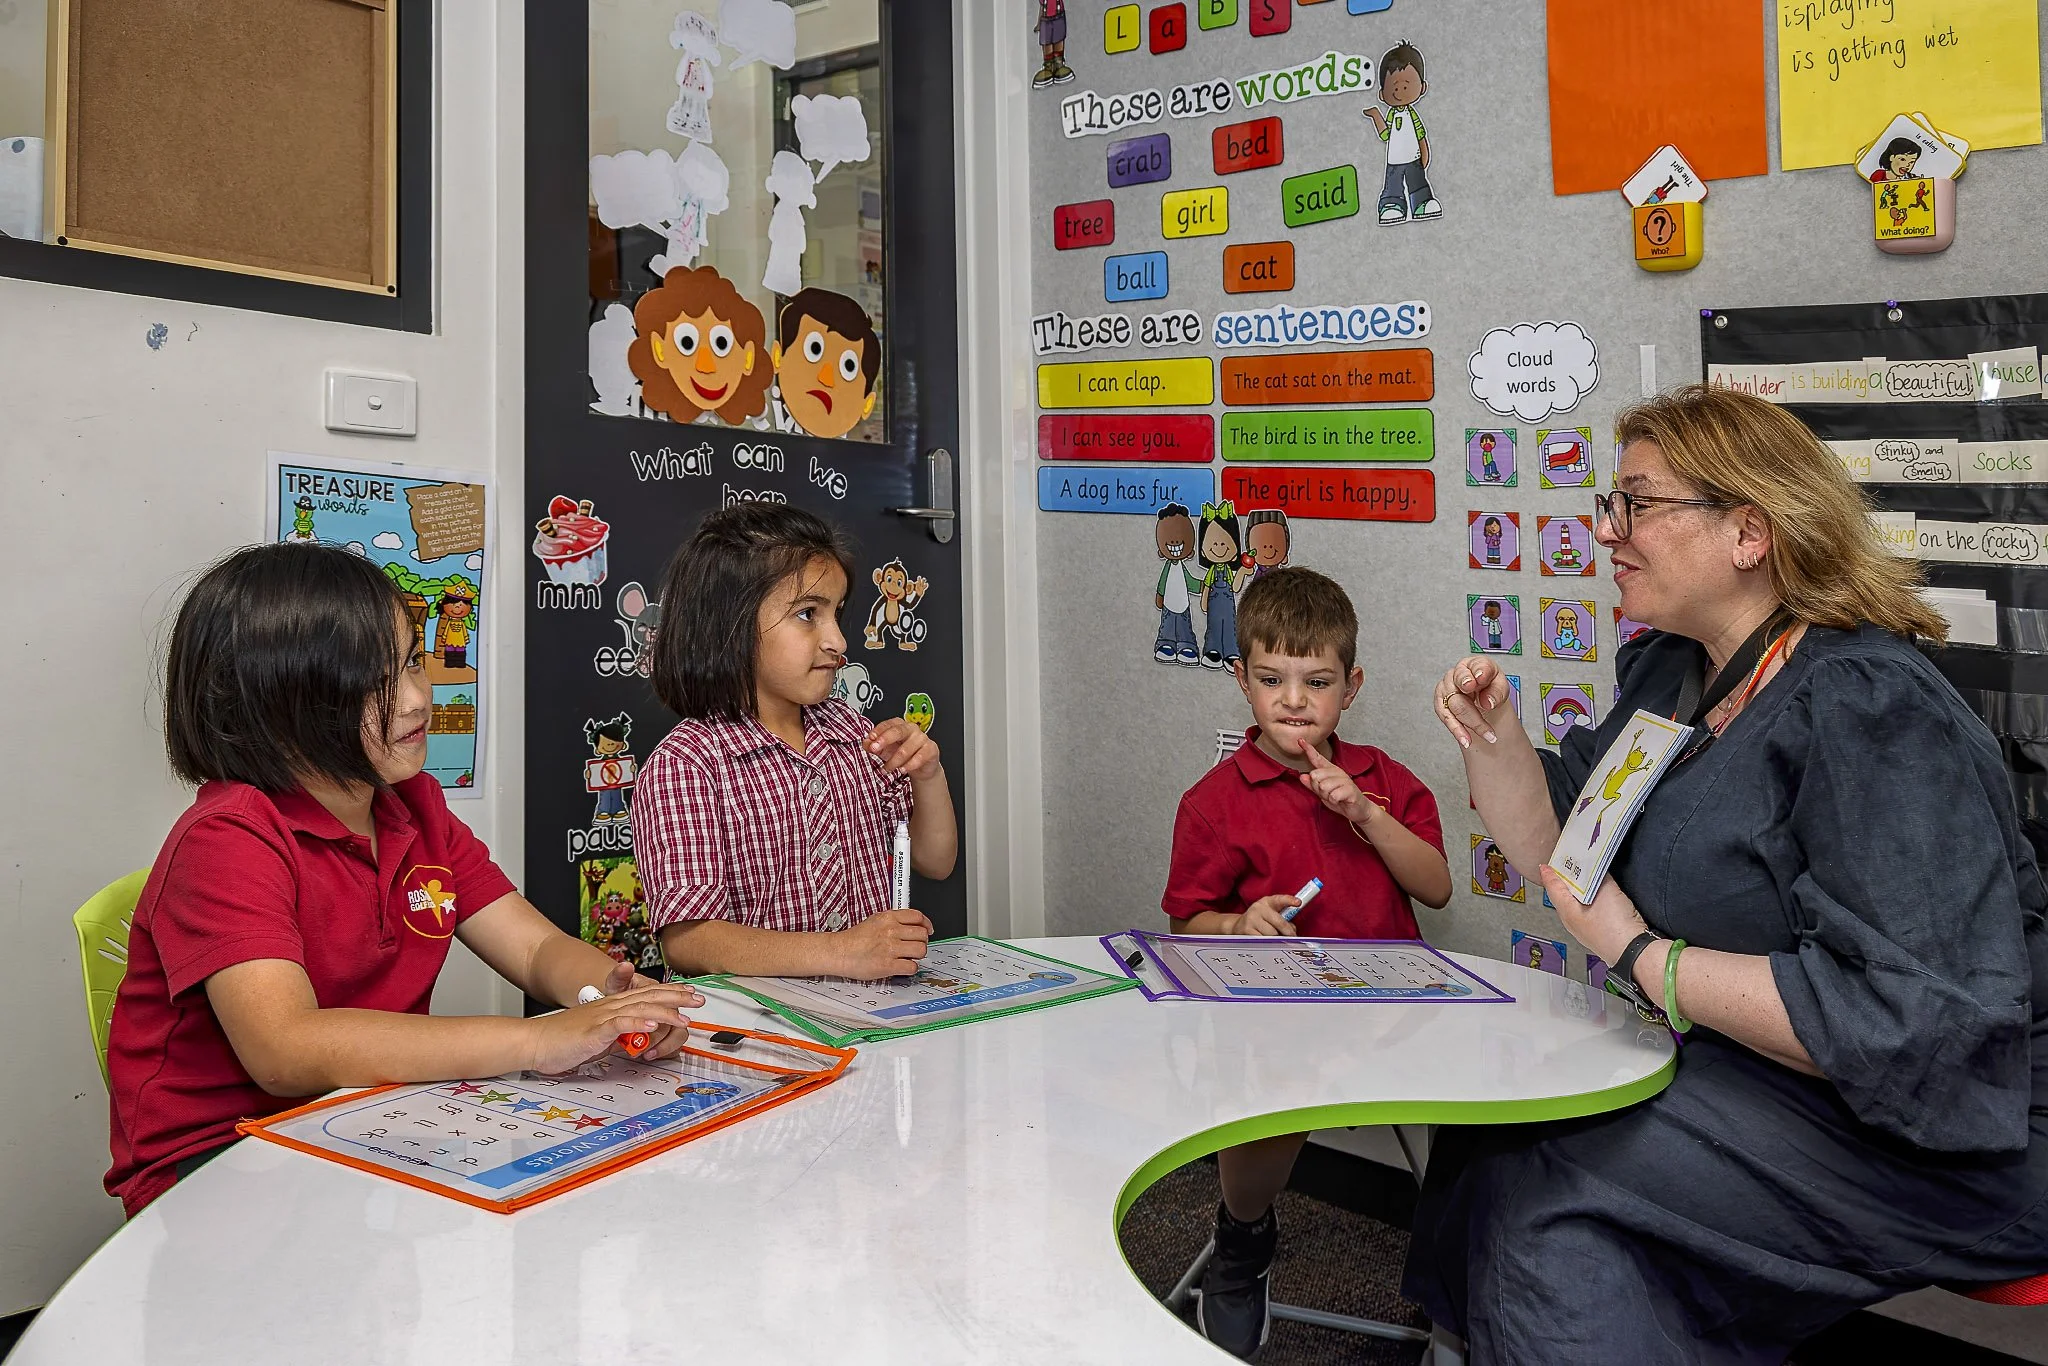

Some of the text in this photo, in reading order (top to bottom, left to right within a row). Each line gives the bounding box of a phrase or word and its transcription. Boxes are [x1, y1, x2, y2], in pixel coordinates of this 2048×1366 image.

[1116, 16, 1127, 39] L
[1161, 18, 1175, 38] a
[1793, 25, 1958, 81] is getting wet
[1063, 53, 1372, 134] These are words:
[1227, 125, 1270, 160] bed
[1115, 143, 1163, 177] crab
[1294, 176, 1348, 214] said
[1064, 216, 1104, 239] tree
[1177, 195, 1215, 234] girl
[1880, 226, 1930, 236] What doing?
[1651, 247, 1670, 256] Who?
[1117, 261, 1157, 291] ball
[1240, 255, 1278, 280] cat
[1033, 303, 1427, 352] These are sentences:
[1507, 350, 1553, 368] Cloud
[1088, 377, 1119, 392] can
[1125, 369, 1166, 397] clap.
[1234, 367, 1416, 389] The cat sat on the mat.
[1507, 376, 1556, 394] words
[1729, 373, 1786, 395] builder
[1791, 371, 1806, 389] is
[1812, 368, 1868, 398] building
[1868, 371, 1883, 390] a
[1891, 371, 1971, 395] beautiful
[1072, 432, 1102, 446] can
[1109, 432, 1136, 447] see
[1141, 432, 1180, 454] you.
[1230, 424, 1422, 445] The bird is in the tree.
[1880, 443, 1914, 461] stinky
[1924, 445, 1944, 455] and
[630, 441, 848, 500] What can we
[1910, 465, 1944, 480] smelly
[285, 472, 396, 502] TREASURE
[1060, 477, 1183, 507] A dog has fur.
[1235, 476, 1417, 510] The girl is happy.
[317, 493, 370, 516] words
[1919, 532, 1942, 547] on
[1946, 530, 1979, 550] the
[1987, 532, 2030, 558] rocky
[537, 580, 601, 609] mm
[594, 646, 636, 677] ee
[856, 679, 884, 709] or
[525, 1141, 601, 1169] Words
